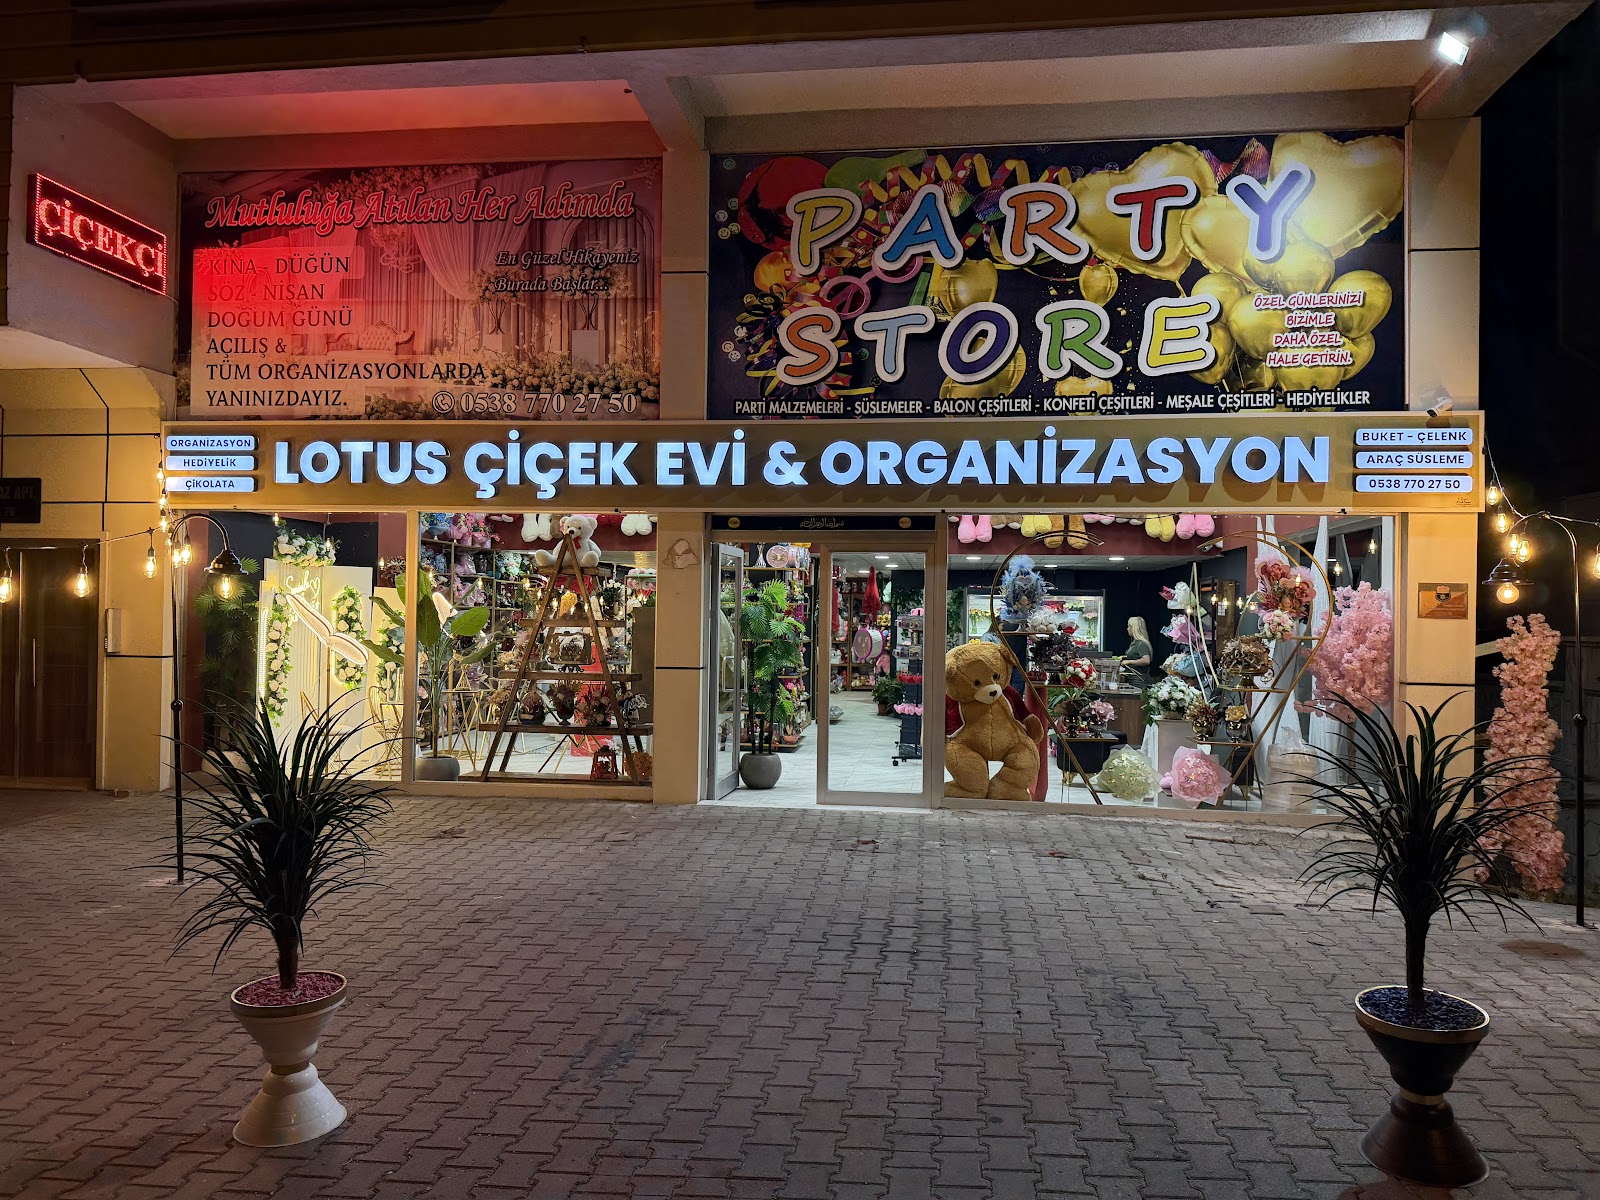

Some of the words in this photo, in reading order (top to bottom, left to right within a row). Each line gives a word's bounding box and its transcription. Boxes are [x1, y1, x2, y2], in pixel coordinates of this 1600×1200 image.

[205, 189, 355, 235] Mutluluğa
[354, 186, 451, 228] Atılan
[456, 186, 517, 222] Her
[513, 180, 635, 224] Adımda
[786, 161, 1313, 276] PARTY
[38, 198, 165, 278] ÇİÇEKÇİ
[209, 257, 257, 274] KINA
[275, 253, 350, 274] DÜĞÜN
[495, 251, 517, 266] En
[521, 249, 564, 269] Güzel
[564, 248, 639, 269] Hikayeniz
[208, 281, 245, 301] SÖZ
[263, 280, 325, 304] NİŞAN
[495, 276, 547, 291] Burada
[551, 275, 608, 293] Başlar...
[1254, 293, 1285, 307] ÖZEL
[1288, 291, 1362, 306] GÜNLERİNİZİ
[208, 306, 285, 328] DOĞUM
[291, 306, 353, 327] GÜNÜ
[1286, 311, 1333, 326] BİZİMLE
[206, 337, 269, 358] AÇILIŞ
[275, 338, 286, 353] &
[776, 294, 1221, 386] STORE
[1274, 334, 1306, 345] DAHA
[1310, 331, 1342, 345] ÖZEL
[1268, 352, 1300, 365] HALE
[1302, 349, 1351, 364] GETİRİN.
[206, 360, 251, 380] TÜM
[258, 358, 486, 380] ORGANİZASYONLARDA
[206, 389, 348, 407] YANINIZDAYIZ.
[460, 392, 517, 413] 0538
[523, 392, 567, 413] 770
[573, 392, 602, 413] 27
[608, 392, 637, 413] 50
[735, 397, 766, 414] PARTİ
[769, 397, 844, 414] MALZEMELERİ
[854, 397, 923, 414] SÜSLEMELER
[934, 400, 975, 413] BALON
[979, 394, 1032, 415] ÇEŞİTLERİ
[1043, 392, 1096, 412] KONFETİ
[1099, 391, 1154, 413] ÇEŞİTLERİ
[1166, 394, 1214, 411] MEŞALE
[1218, 389, 1275, 410] ÇEŞİTLERİ
[1286, 387, 1370, 406] HEDİYELİKLER
[170, 437, 251, 447] ORGANİZASYON
[1362, 432, 1404, 441] BUKET
[1417, 431, 1467, 443] ÇELENK
[275, 440, 448, 485] LOTUS
[463, 429, 639, 499] ÇİÇEK
[656, 429, 745, 486] EVİ
[763, 440, 809, 486] &
[819, 425, 1329, 486] ORGANİZASYON
[1366, 455, 1403, 466] ARAÇ
[1407, 452, 1464, 464] SÜSLEME
[1369, 479, 1401, 488] 0538
[1404, 479, 1425, 488] 770
[1428, 479, 1441, 488] 27
[1445, 480, 1460, 489] 50
